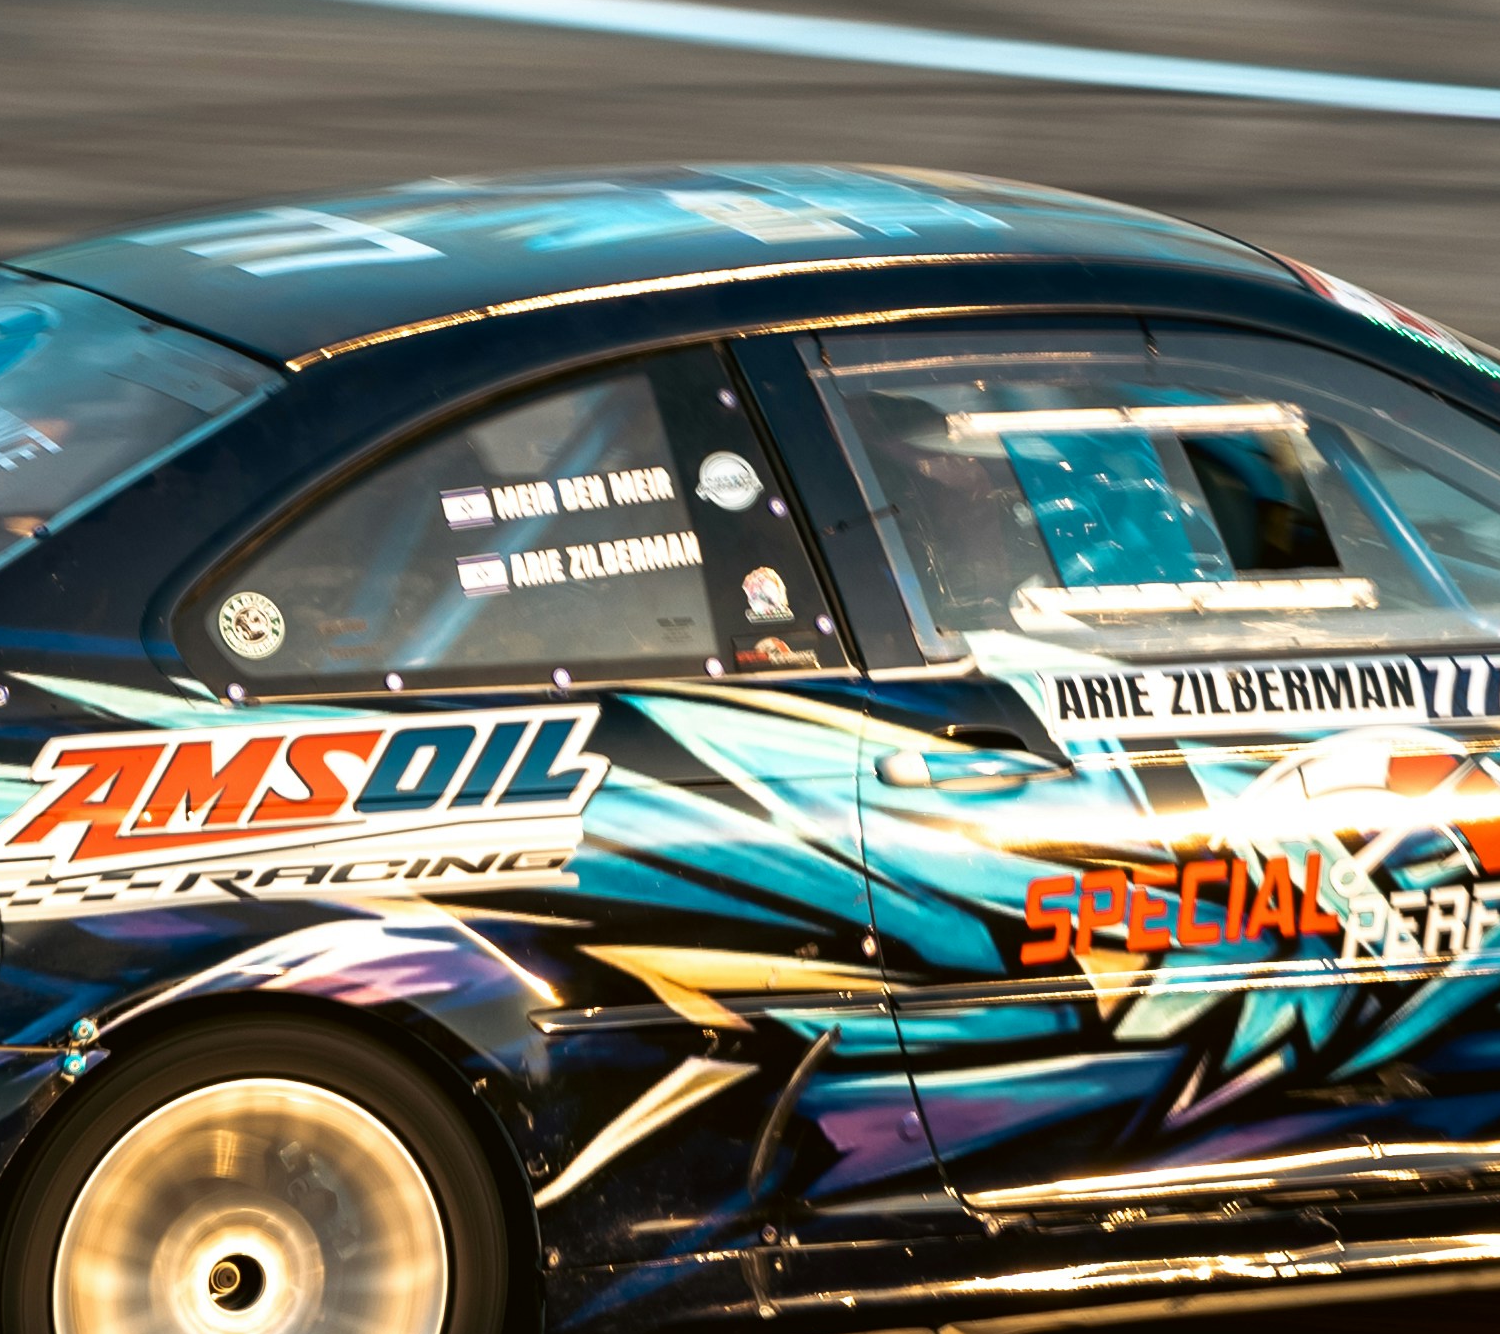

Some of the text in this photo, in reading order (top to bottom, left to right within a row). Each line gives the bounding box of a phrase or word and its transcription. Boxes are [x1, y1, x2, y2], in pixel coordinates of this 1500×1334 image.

[491, 481, 559, 521] MEIR
[557, 475, 609, 513] BEN
[608, 466, 676, 505] MEIR
[509, 531, 703, 588] ARIE ZILBERMAN
[1055, 671, 1154, 721] ARIE
[1169, 661, 1416, 717] ZILBERMAN
[5, 717, 600, 862] AMSOIL
[172, 850, 572, 902] RACING
[1019, 850, 1339, 966] SPECIAL
